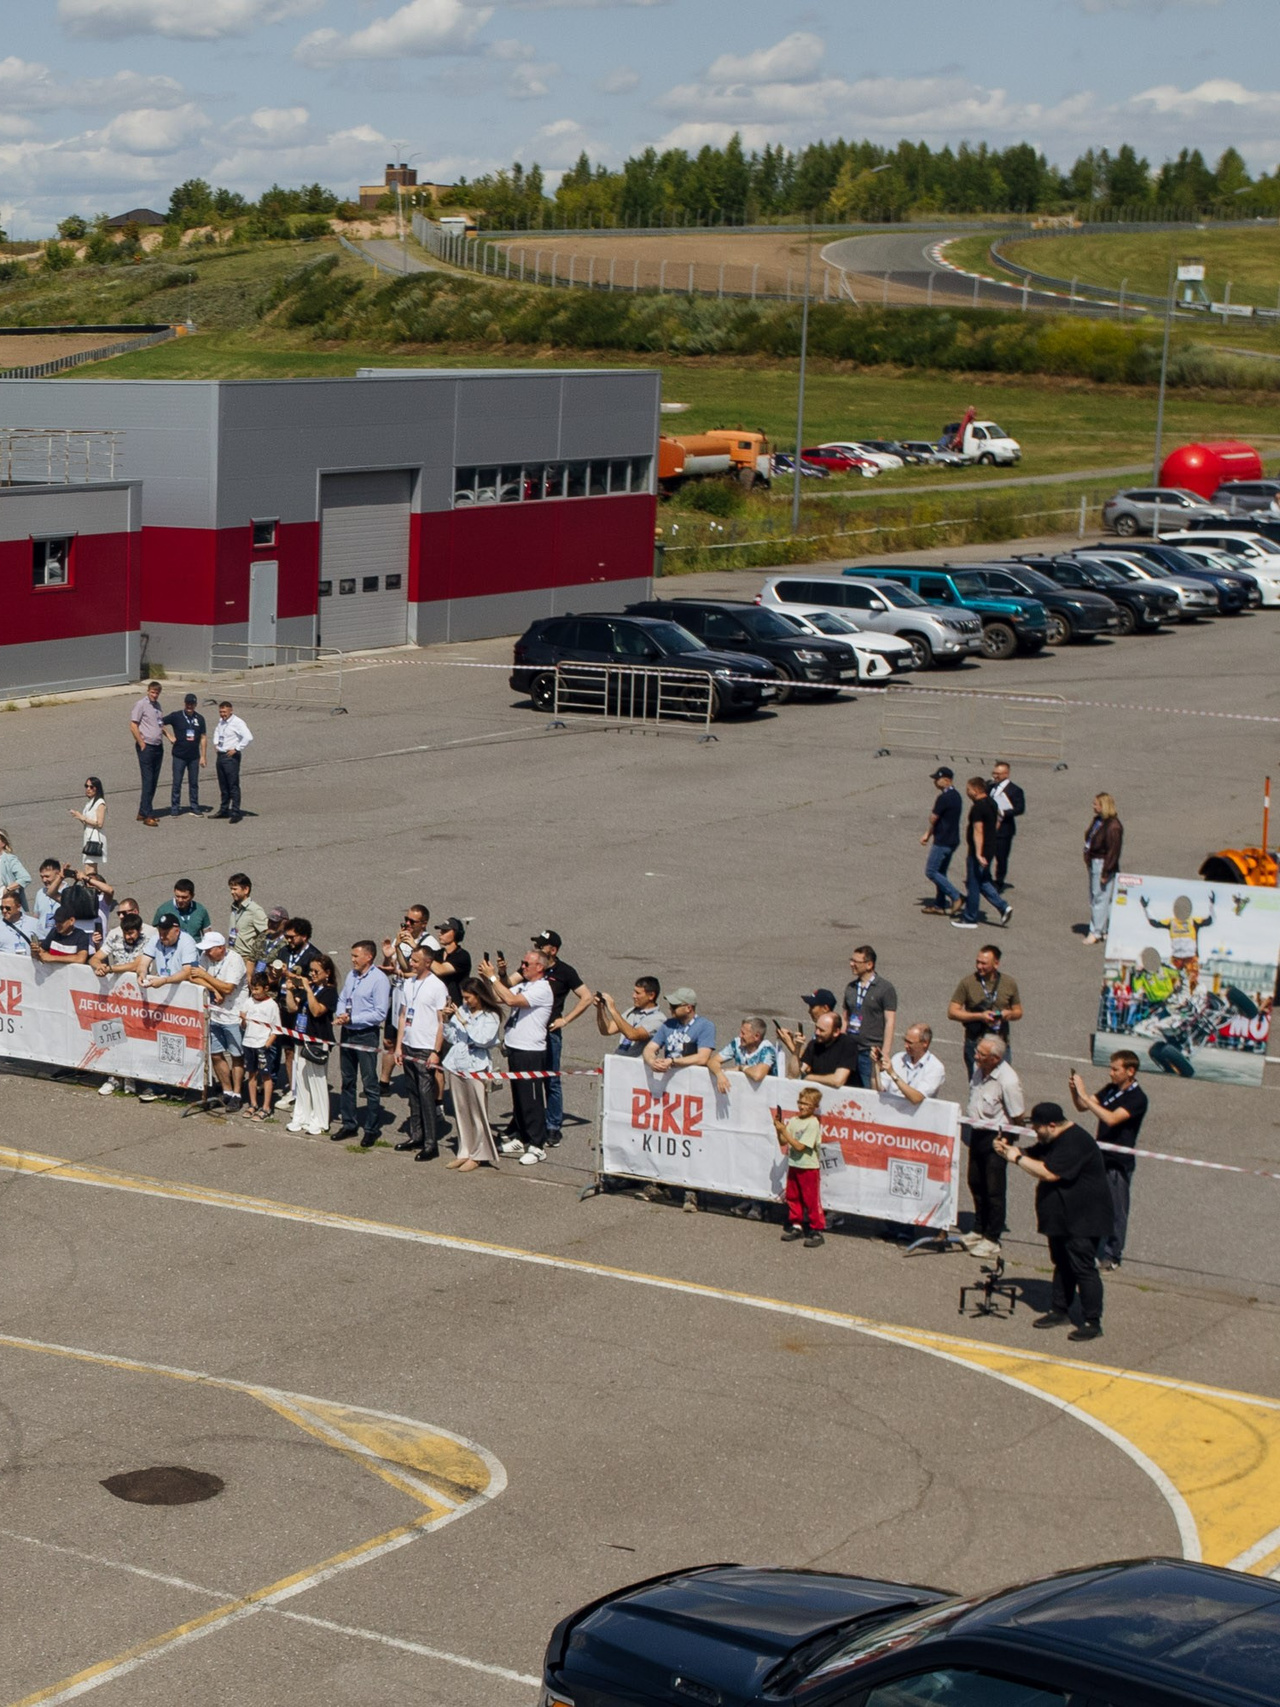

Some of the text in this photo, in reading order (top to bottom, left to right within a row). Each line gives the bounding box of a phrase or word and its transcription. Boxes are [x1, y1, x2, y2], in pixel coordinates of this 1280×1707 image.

[79, 998, 202, 1028] ДЕТСКАЯ МОТОШКОЛА
[98, 1031, 122, 1044] 3 ЛЕТ
[101, 1022, 113, 1032] ОТ
[643, 1133, 691, 1158] KIDS
[852, 1130, 950, 1158] МОТОШКОЛА
